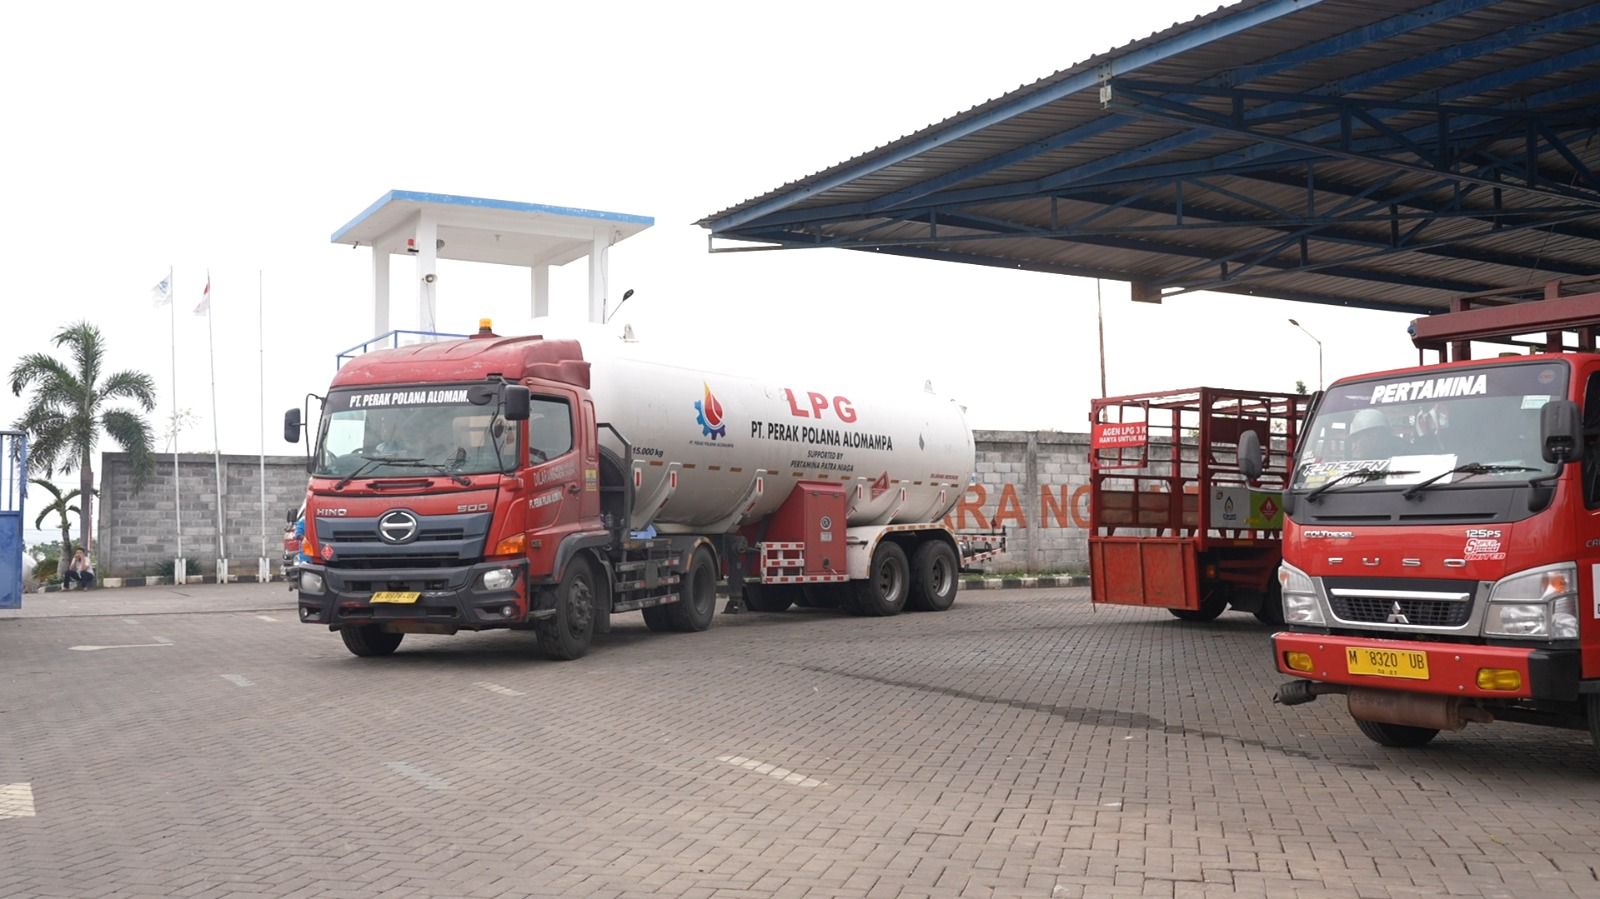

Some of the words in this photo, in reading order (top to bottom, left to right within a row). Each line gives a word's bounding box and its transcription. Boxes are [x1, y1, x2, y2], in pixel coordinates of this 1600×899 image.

[1370, 375, 1487, 404] PERTAMINA
[349, 395, 361, 407] PT.
[362, 393, 391, 407] PERAK
[391, 391, 426, 405] POLANA
[427, 389, 469, 403] ALOMAM
[784, 388, 857, 423] LPG
[751, 421, 764, 439] PT.
[767, 422, 799, 442] PERAK
[802, 426, 841, 446] POLANA
[842, 431, 893, 451] ALOMAMPA
[1103, 428, 1120, 436] AGEN
[1121, 427, 1135, 435] LPG
[1136, 426, 1140, 434] 3
[632, 447, 654, 456] 15.000
[655, 448, 663, 457] kg
[807, 450, 835, 460] SUPPORTED
[790, 460, 820, 469] PERTAMINA
[821, 462, 836, 470] PATRA
[316, 508, 347, 516] HINO
[457, 503, 488, 512] 500
[1465, 529, 1501, 538] 125PS
[1328, 557, 1466, 568] FUSO
[1348, 650, 1358, 664] M
[1369, 651, 1398, 667] 8320
[1409, 653, 1425, 669] UB
